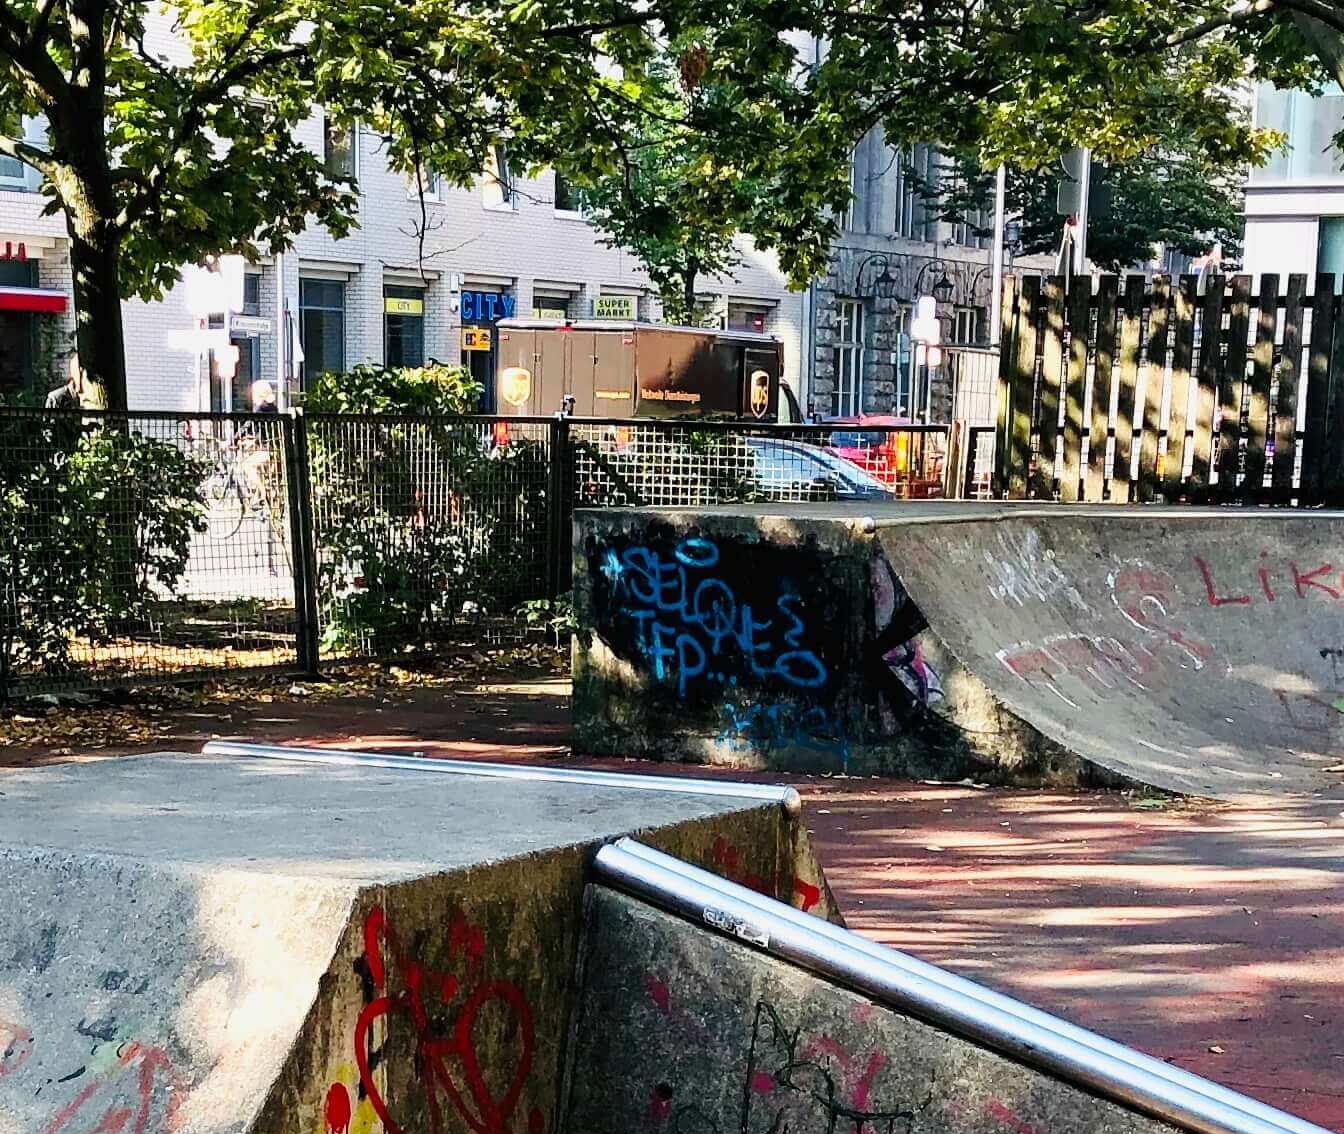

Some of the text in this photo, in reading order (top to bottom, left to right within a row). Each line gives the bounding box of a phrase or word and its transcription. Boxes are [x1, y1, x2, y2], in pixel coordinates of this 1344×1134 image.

[461, 291, 515, 320] CITY
[598, 299, 631, 309] SUPER
[596, 308, 632, 318] MARKT
